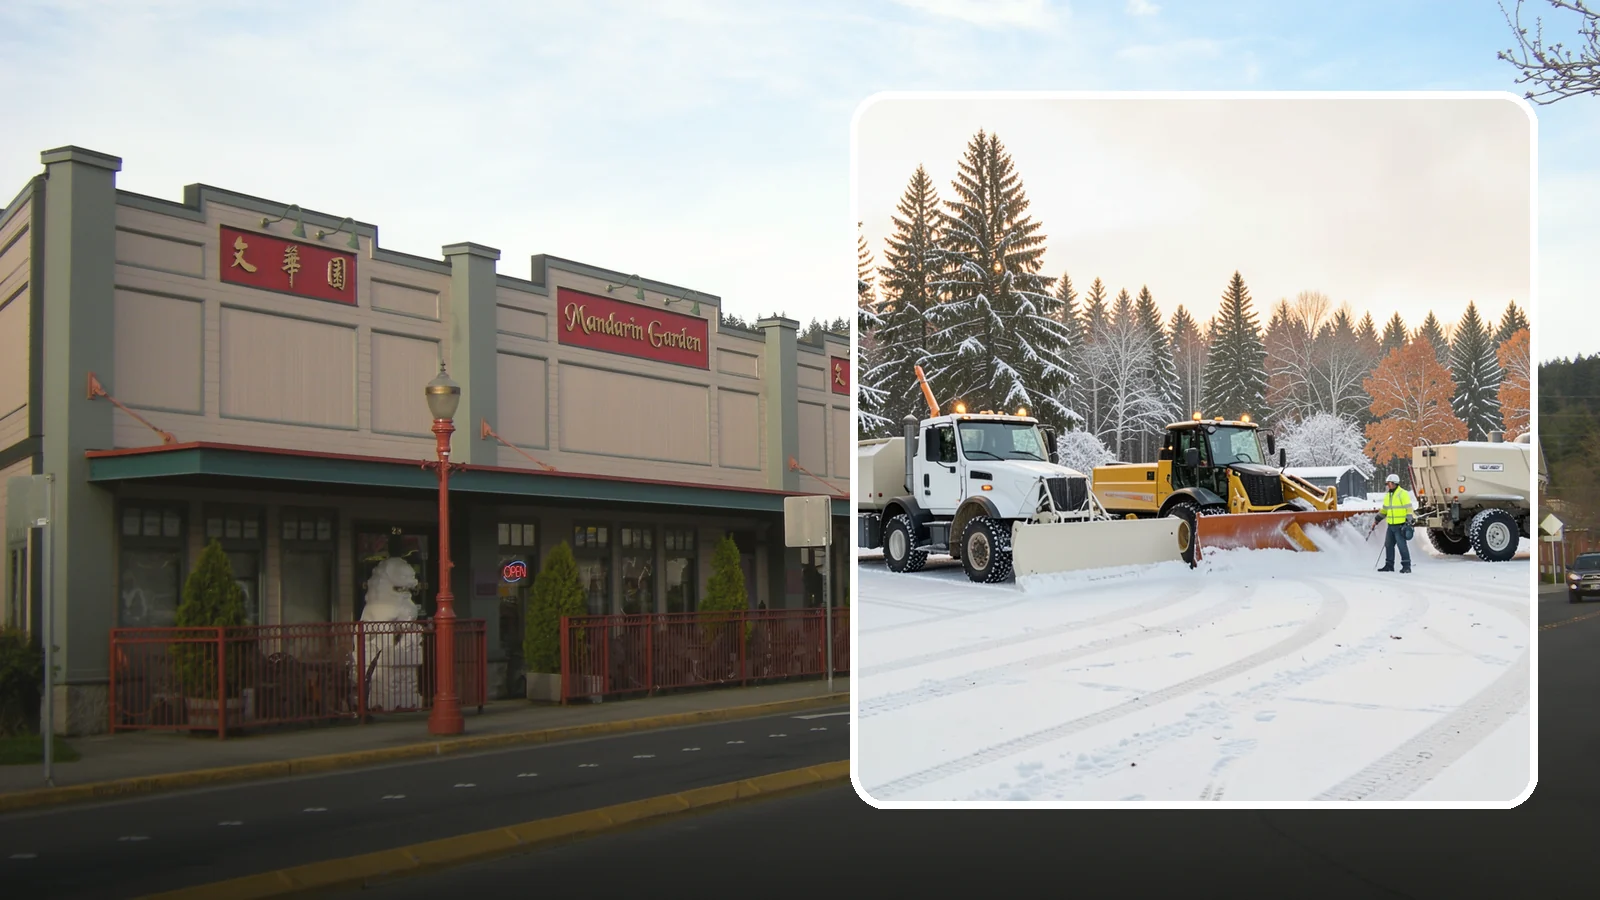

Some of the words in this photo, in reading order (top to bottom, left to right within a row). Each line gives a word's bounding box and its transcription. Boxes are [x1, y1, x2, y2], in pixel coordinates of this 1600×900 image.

[231, 235, 346, 290] 文華園
[564, 302, 644, 340] Mandarin
[647, 320, 701, 351] Garden
[503, 565, 527, 578] OPEN
